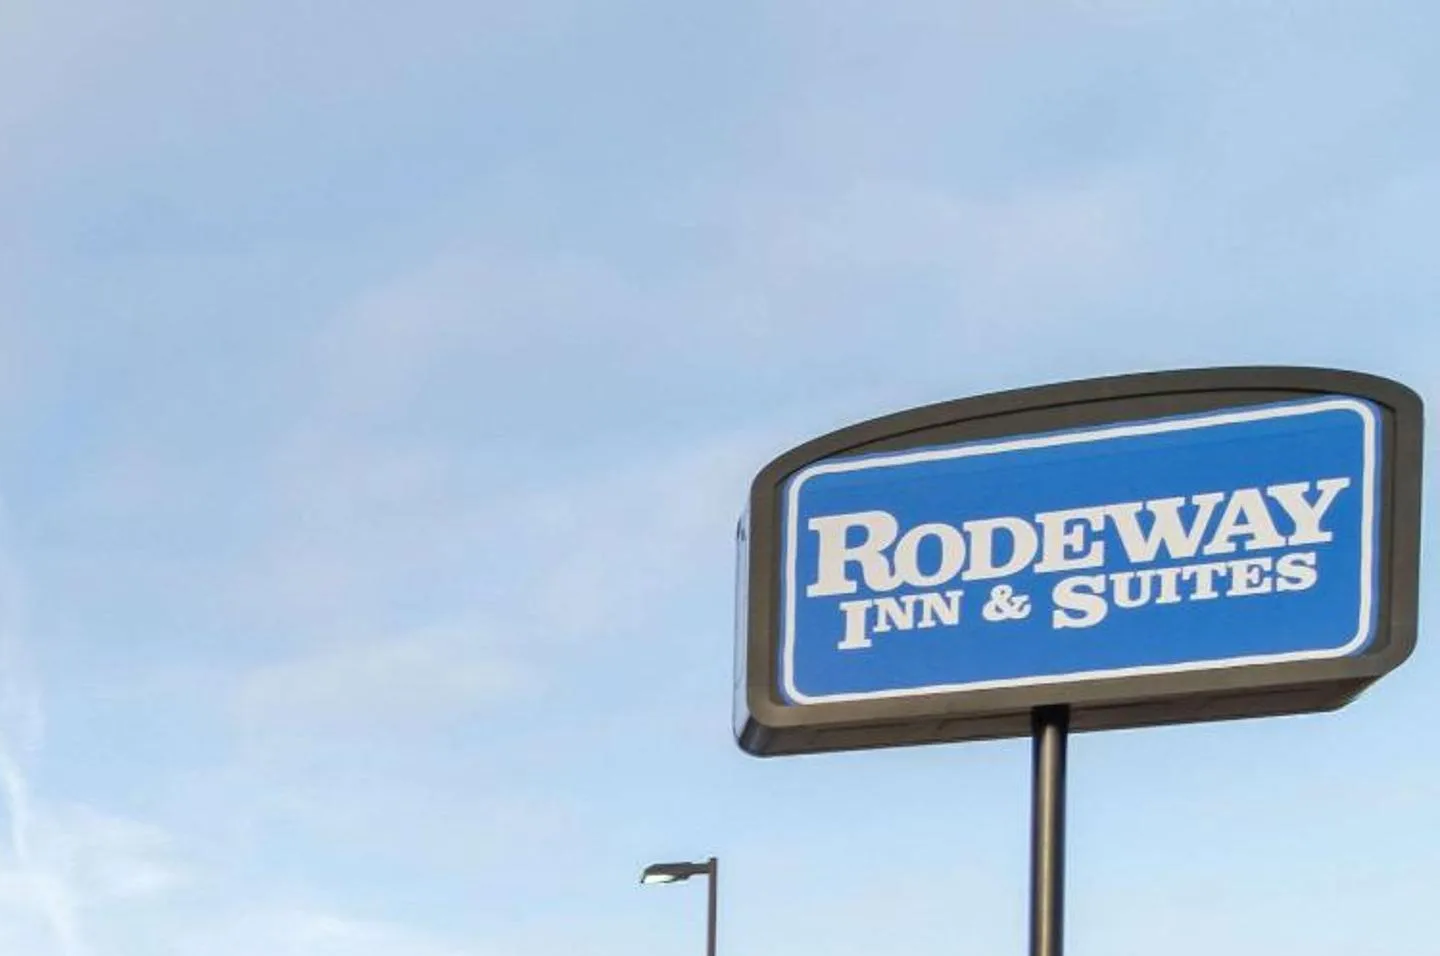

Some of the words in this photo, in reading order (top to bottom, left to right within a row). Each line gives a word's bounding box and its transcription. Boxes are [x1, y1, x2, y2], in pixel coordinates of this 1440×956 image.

[806, 477, 1350, 598] RODEWAY
[837, 590, 963, 650] INN
[982, 584, 1032, 622] &
[1052, 552, 1318, 629] SUITES
